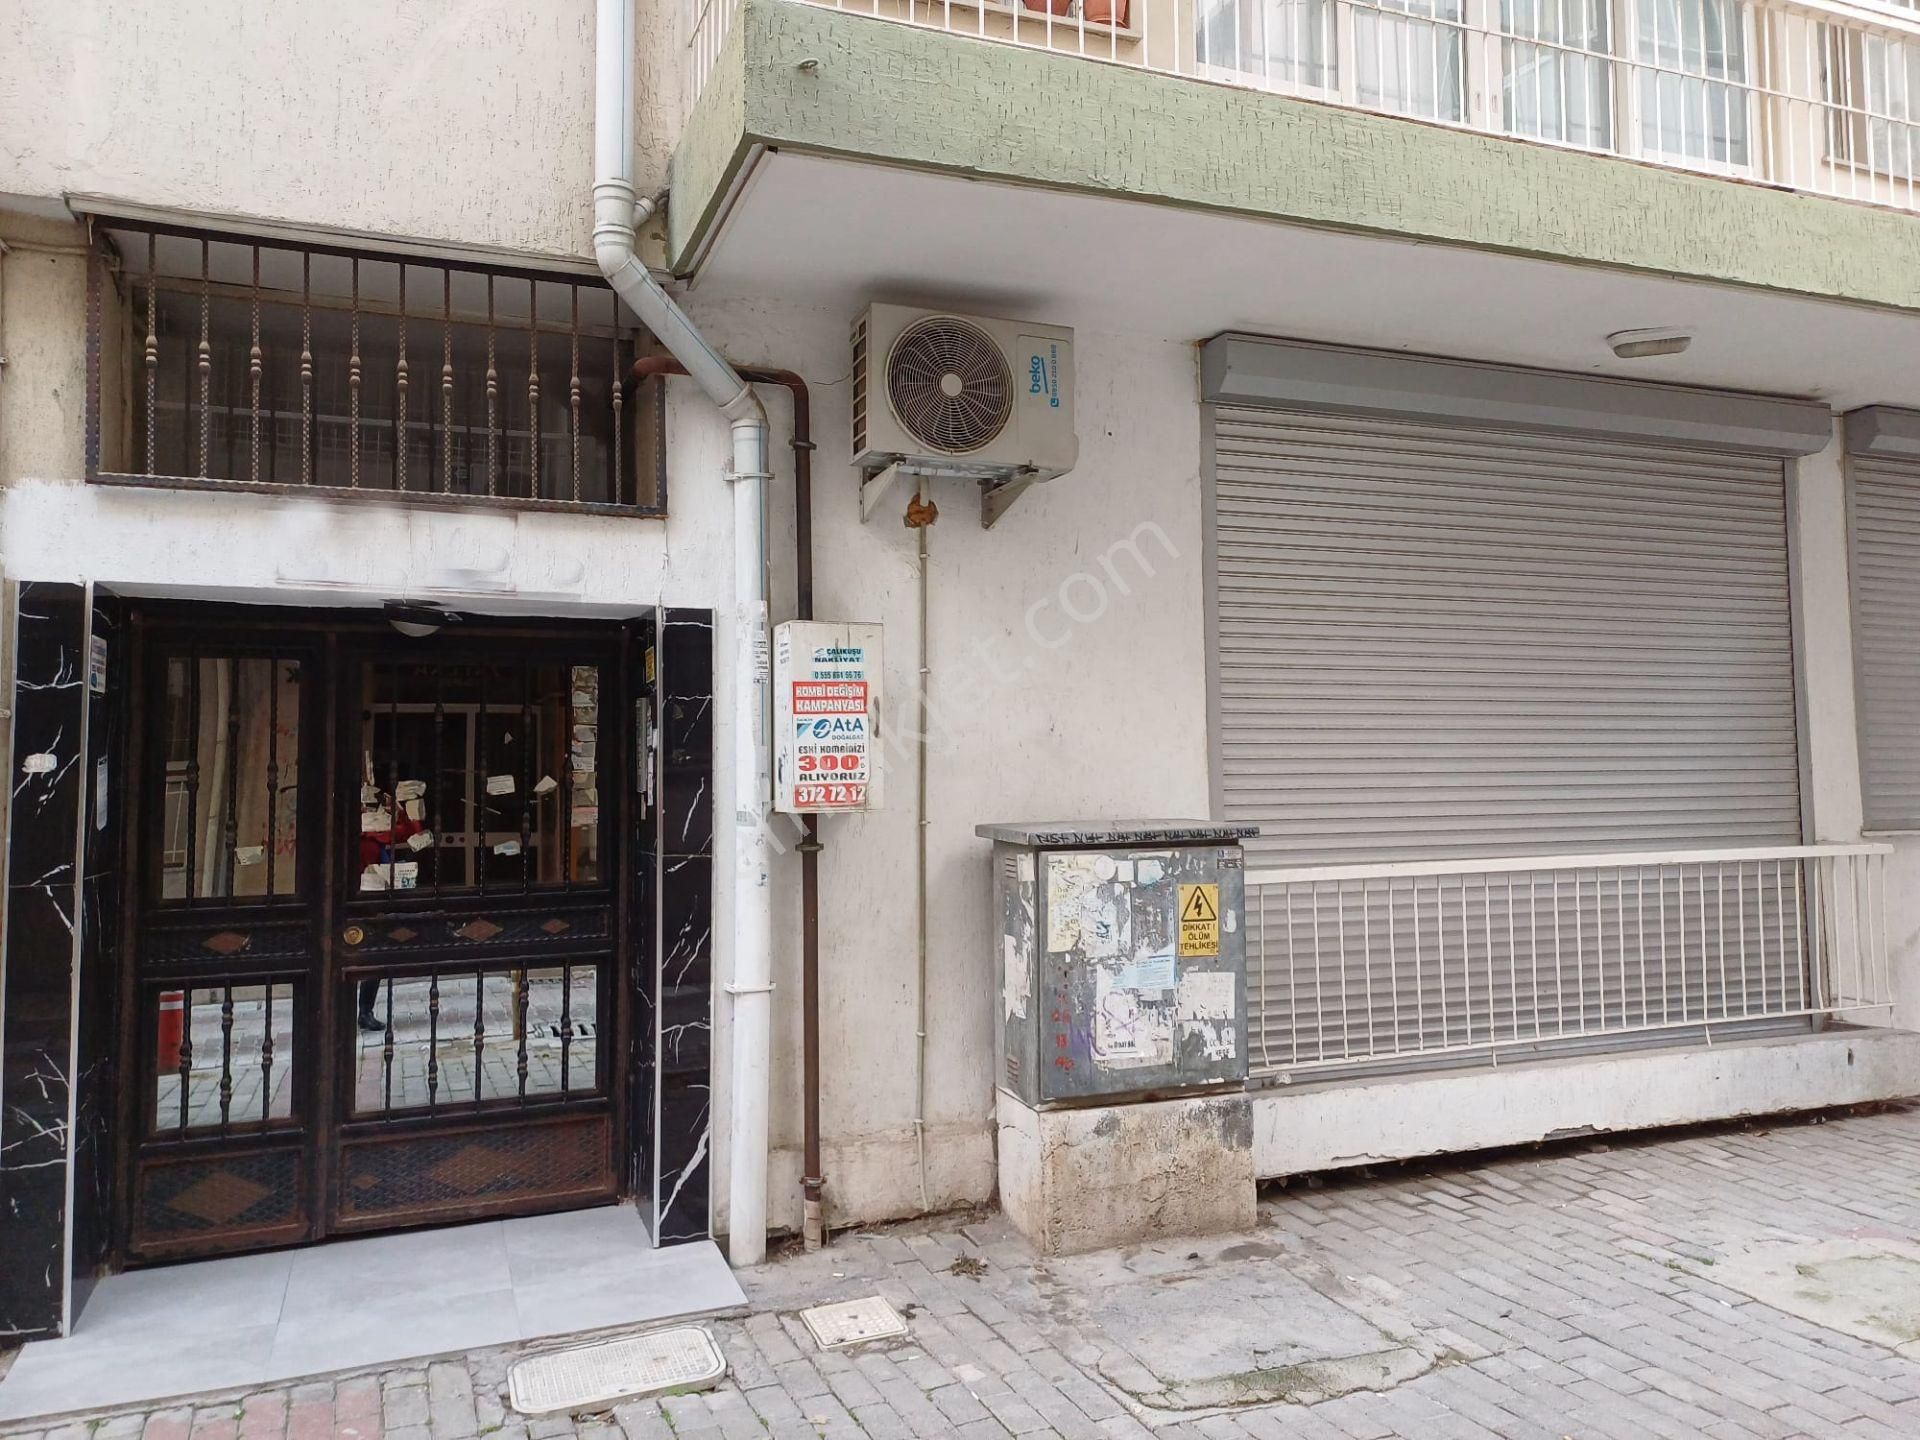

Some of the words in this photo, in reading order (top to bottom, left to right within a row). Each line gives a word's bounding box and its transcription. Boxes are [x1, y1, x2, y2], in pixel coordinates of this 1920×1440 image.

[1028, 355, 1041, 394] beko
[826, 648, 861, 656] ÇALIKUŞU
[796, 684, 826, 698] KOMBİ
[827, 683, 865, 699] DEĞİŞİM
[796, 699, 865, 712] KAMPANYASI
[798, 743, 817, 754] ESKİ
[798, 755, 859, 771] 300
[799, 772, 865, 781] ALIYORUZ
[798, 786, 825, 802] 372
[828, 786, 846, 802] 72
[850, 785, 866, 802] 12
[1183, 923, 1210, 931] DİKKAT
[1188, 932, 1210, 940] ÖLÜM
[1181, 941, 1218, 950] TEHLİKESİ
